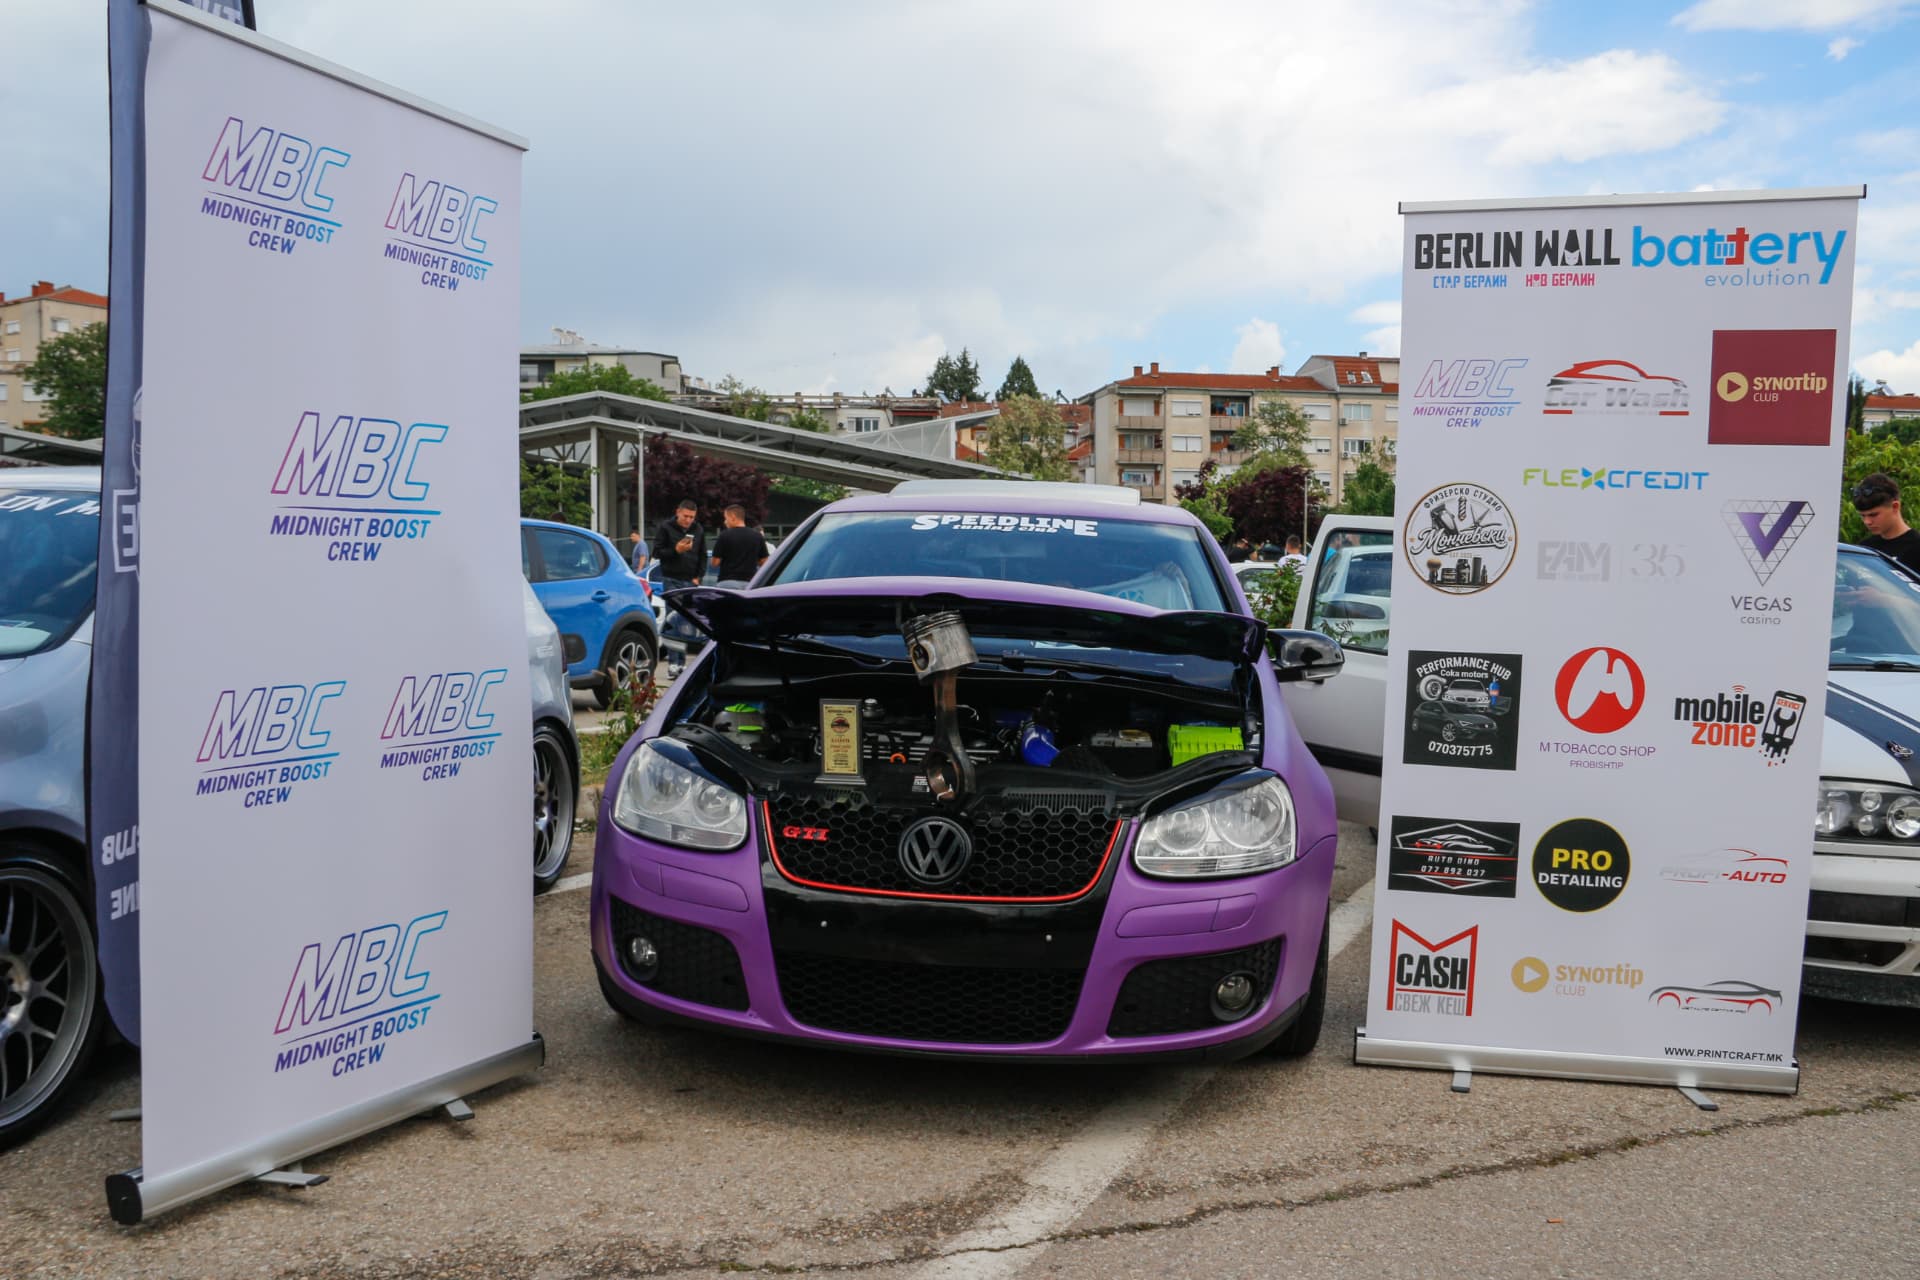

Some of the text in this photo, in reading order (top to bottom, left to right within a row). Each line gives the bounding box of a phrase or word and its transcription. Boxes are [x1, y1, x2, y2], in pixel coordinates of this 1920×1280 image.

[203, 116, 351, 213] MBC
[201, 197, 335, 244] MIDNIGHT BOOST
[384, 172, 498, 254] MBC
[248, 230, 296, 255] CREW
[1414, 228, 1621, 270] BERLIN WALL
[384, 243, 488, 281] MIDNIGHT BOOST
[1631, 225, 1848, 285] battery
[421, 271, 460, 291] CREW
[1704, 268, 1810, 287] evolution
[1413, 358, 1529, 399] MBC
[1753, 392, 1779, 402] CLUB
[1413, 406, 1514, 417] MIDNIGHT BOOST
[1446, 417, 1482, 428] CREW
[271, 411, 449, 502] MBC
[270, 514, 432, 539] MIDNIGHT BOOST
[911, 514, 1098, 537] SPEEDLINE
[328, 541, 382, 561] CREW
[1731, 595, 1793, 612] VEGAS
[1740, 614, 1782, 625] casino
[1416, 656, 1512, 681] PERFORMANCE HUB
[1461, 670, 1489, 679] motors
[380, 668, 507, 739] MBC
[1674, 692, 1765, 725] mobile
[196, 680, 347, 763] MBC
[1691, 722, 1757, 748] zone
[380, 740, 496, 768] MIDNIGHT BOOST
[1428, 740, 1493, 757] 070375775
[1539, 741, 1656, 757] M TOBACCO SHOP
[422, 762, 461, 781] CREW
[1569, 760, 1624, 769] PROBISHTIP
[196, 761, 332, 796] MIDNIGHT BOOST
[244, 786, 292, 808] CREW
[782, 825, 830, 841] GTI
[1551, 848, 1613, 871] PRO
[1538, 872, 1623, 889] DETAILING
[273, 910, 449, 1035] MBC
[1396, 953, 1469, 991] CASH
[1555, 984, 1586, 997] CLUB
[1394, 993, 1466, 1017] СВЕЖ КЕШ
[274, 1006, 432, 1072] MIDNIGHT BOOST
[332, 1043, 386, 1077] CREW
[1664, 1047, 1783, 1062] WWW.PRINTCRAFT.MK
